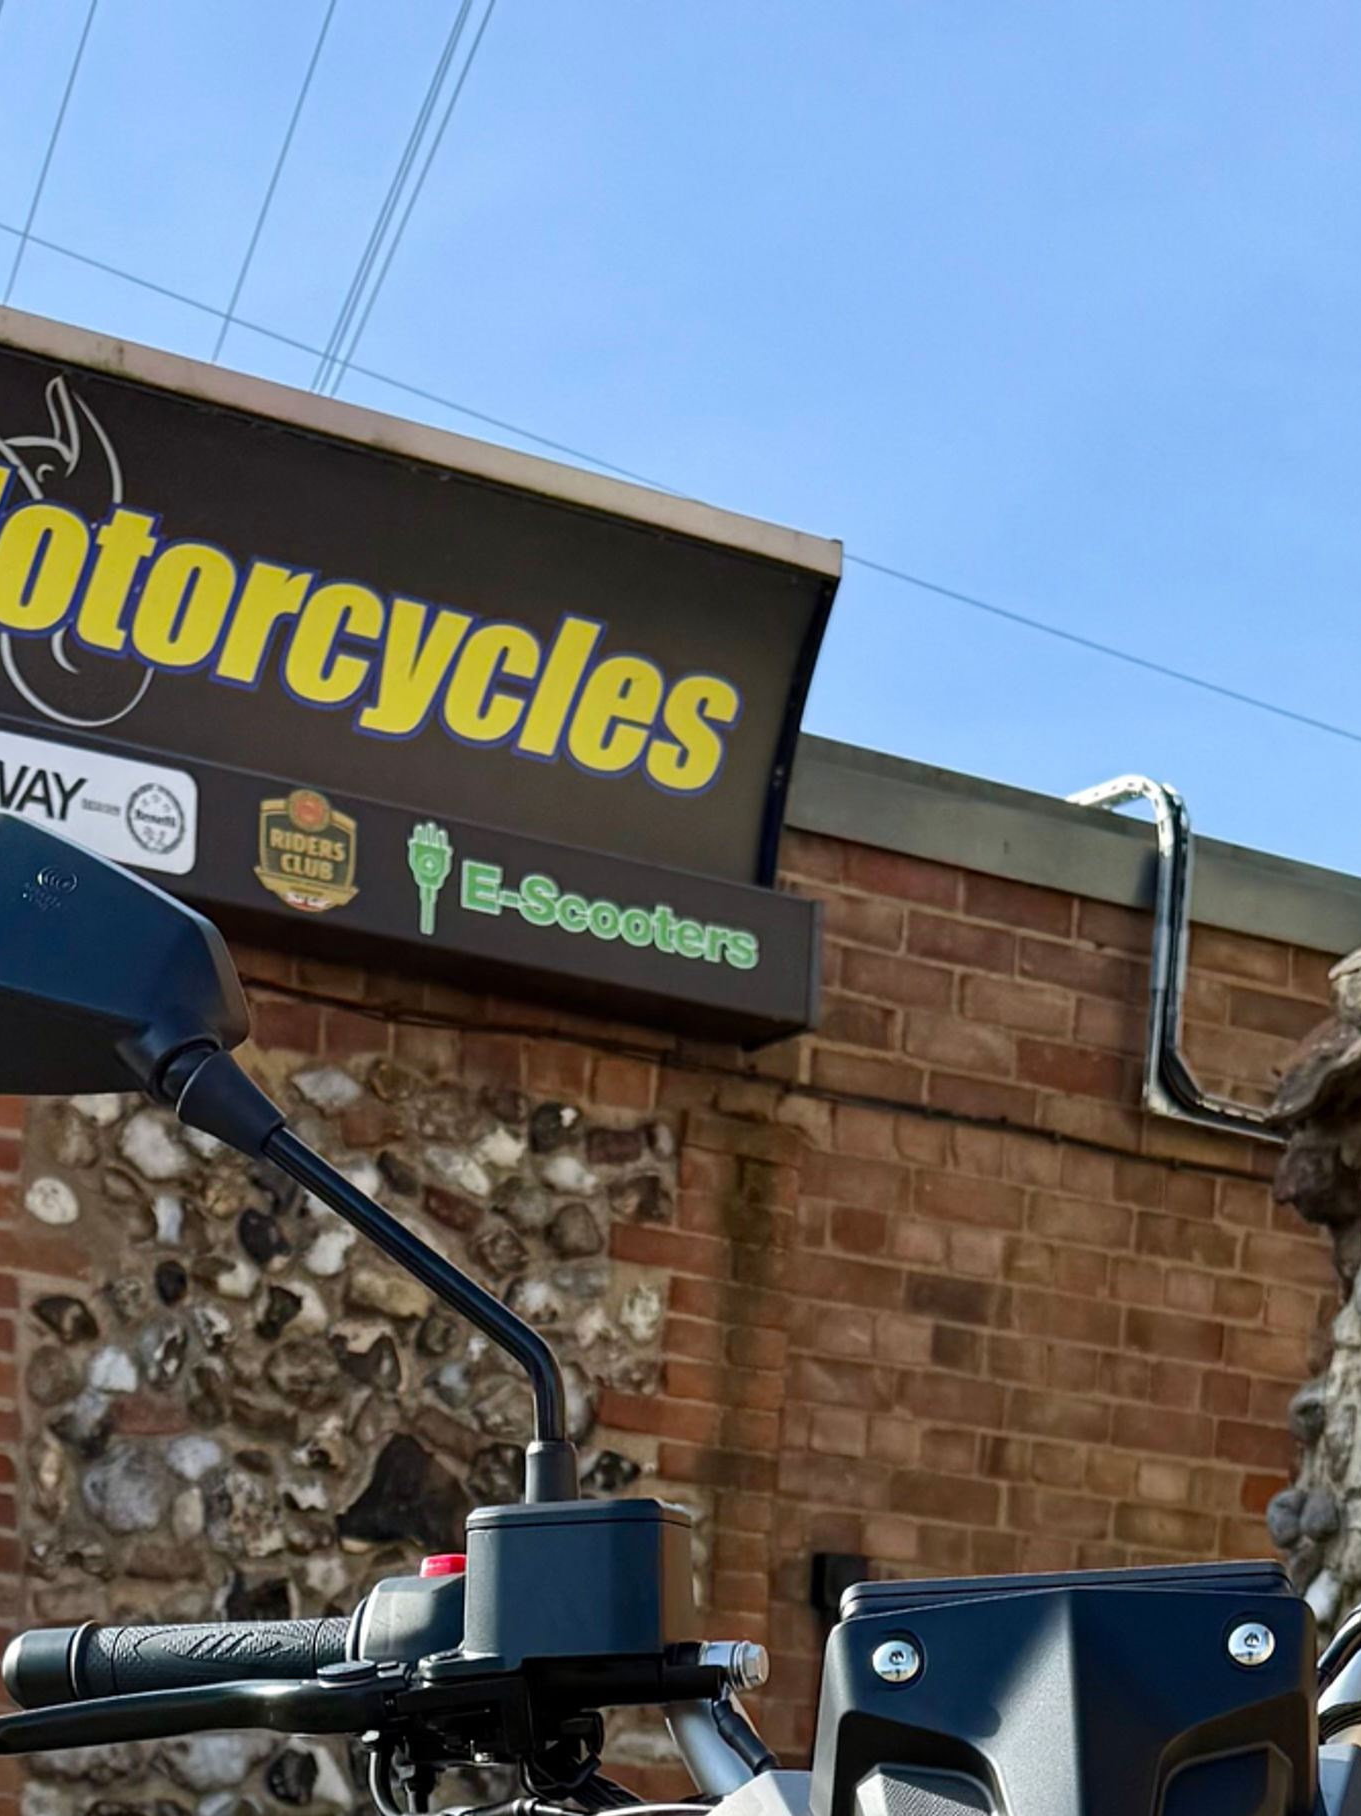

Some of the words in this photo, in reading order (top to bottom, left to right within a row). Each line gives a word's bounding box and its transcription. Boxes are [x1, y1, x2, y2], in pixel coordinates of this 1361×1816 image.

[269, 827, 346, 861] RIDERS
[280, 853, 334, 881] CLUB
[460, 858, 759, 969] E-Scooters
